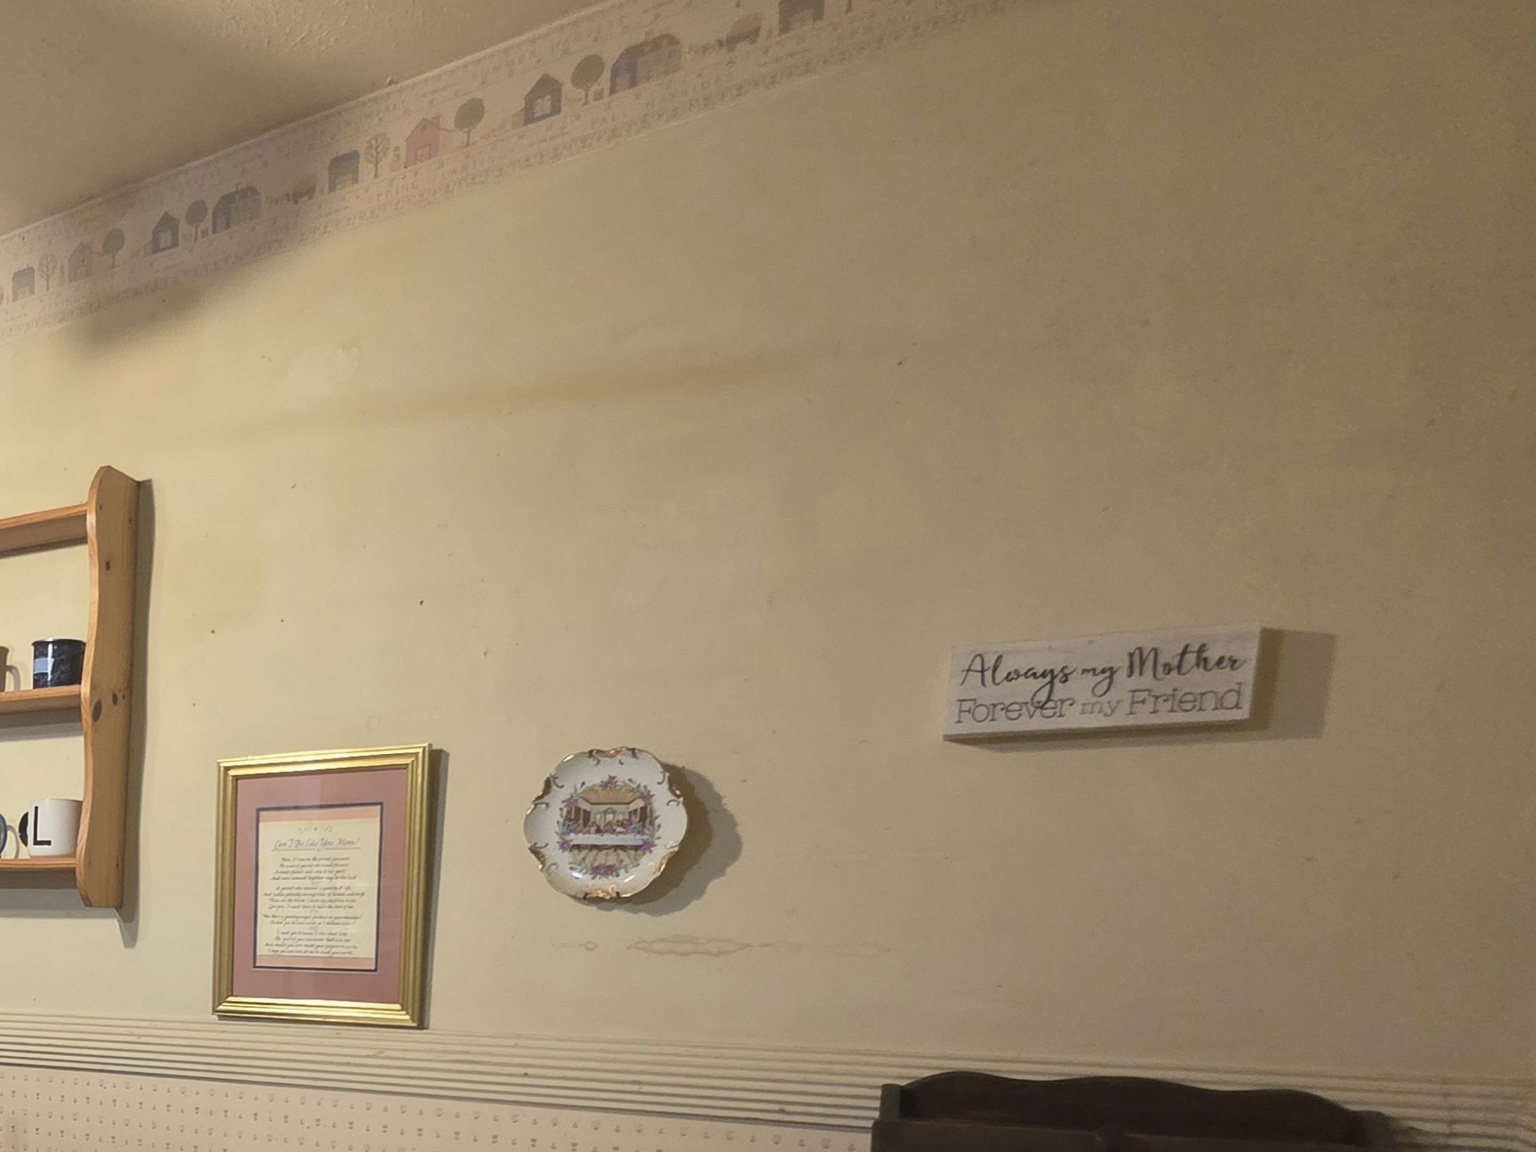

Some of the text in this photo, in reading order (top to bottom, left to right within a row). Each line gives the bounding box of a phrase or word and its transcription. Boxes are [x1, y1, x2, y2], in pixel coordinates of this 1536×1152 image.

[960, 642, 1248, 709] Always my Mother
[953, 682, 1244, 724] Forever my Friend
[32, 805, 52, 846] L
